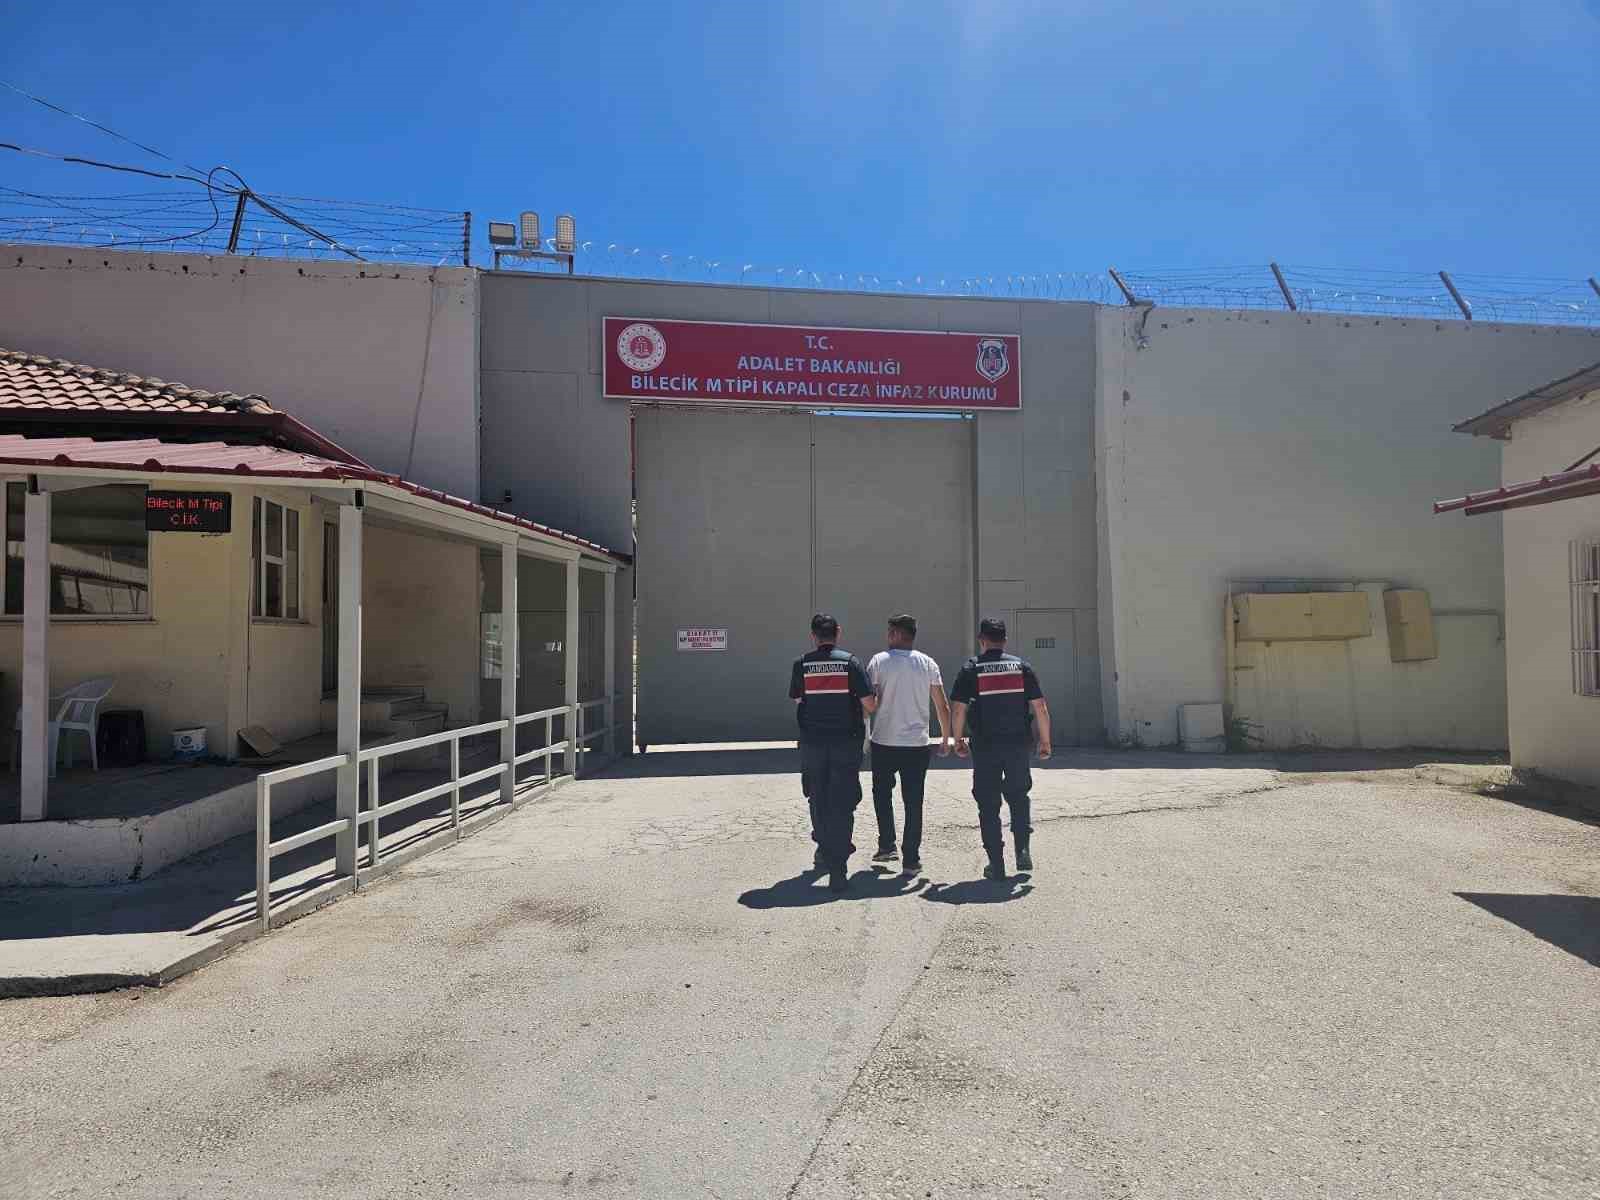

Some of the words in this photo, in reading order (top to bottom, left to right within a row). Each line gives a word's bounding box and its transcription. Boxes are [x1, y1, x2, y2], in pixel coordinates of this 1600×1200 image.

[805, 335, 834, 350] T.C.
[737, 355, 805, 372] ADALET
[810, 358, 901, 376] BAKANLIĞI
[631, 373, 698, 391] BİLECİK
[706, 379, 722, 392] M
[725, 376, 758, 393] TİPİ
[762, 380, 823, 396] KAPALI
[827, 382, 871, 397] CEZA
[876, 381, 924, 399] İNFAZ
[927, 385, 998, 400] KURUMU
